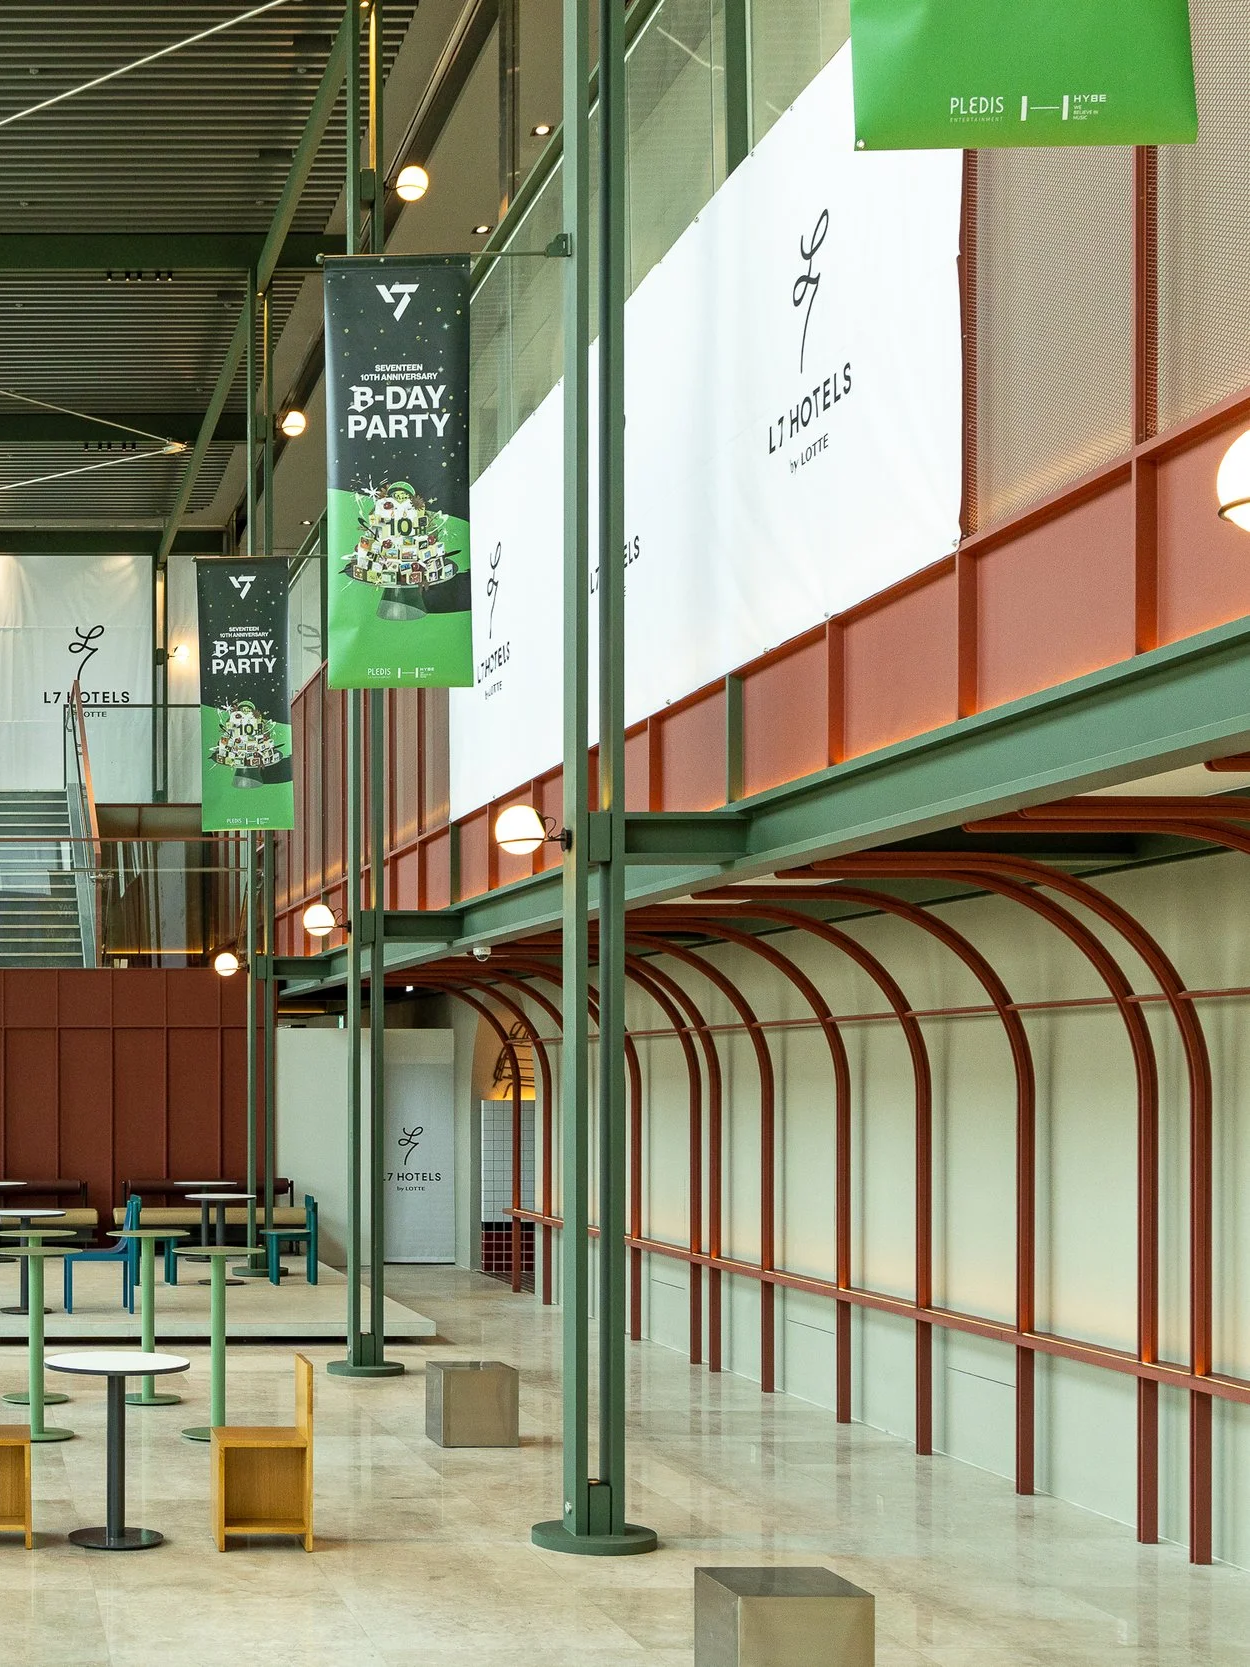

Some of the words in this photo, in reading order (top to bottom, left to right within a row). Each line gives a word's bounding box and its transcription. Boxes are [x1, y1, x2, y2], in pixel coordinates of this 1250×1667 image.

[950, 96, 1004, 115] PLEDIS
[1073, 94, 1107, 103] HYBE
[375, 363, 423, 372] SEVENTEEN
[360, 373, 380, 381] 10TH
[381, 372, 438, 381] ANNIVERSARY
[347, 384, 446, 413] B-DAY
[769, 415, 784, 455] L7
[789, 362, 852, 438] HOTELS
[347, 413, 451, 439] PARTY
[801, 433, 829, 466] LOTTE
[211, 640, 274, 658] B-DAY
[211, 658, 277, 675] PARTY
[367, 667, 391, 676] PLEDIS
[43, 691, 61, 704] L7
[397, 1172, 441, 1182] HOTELS
